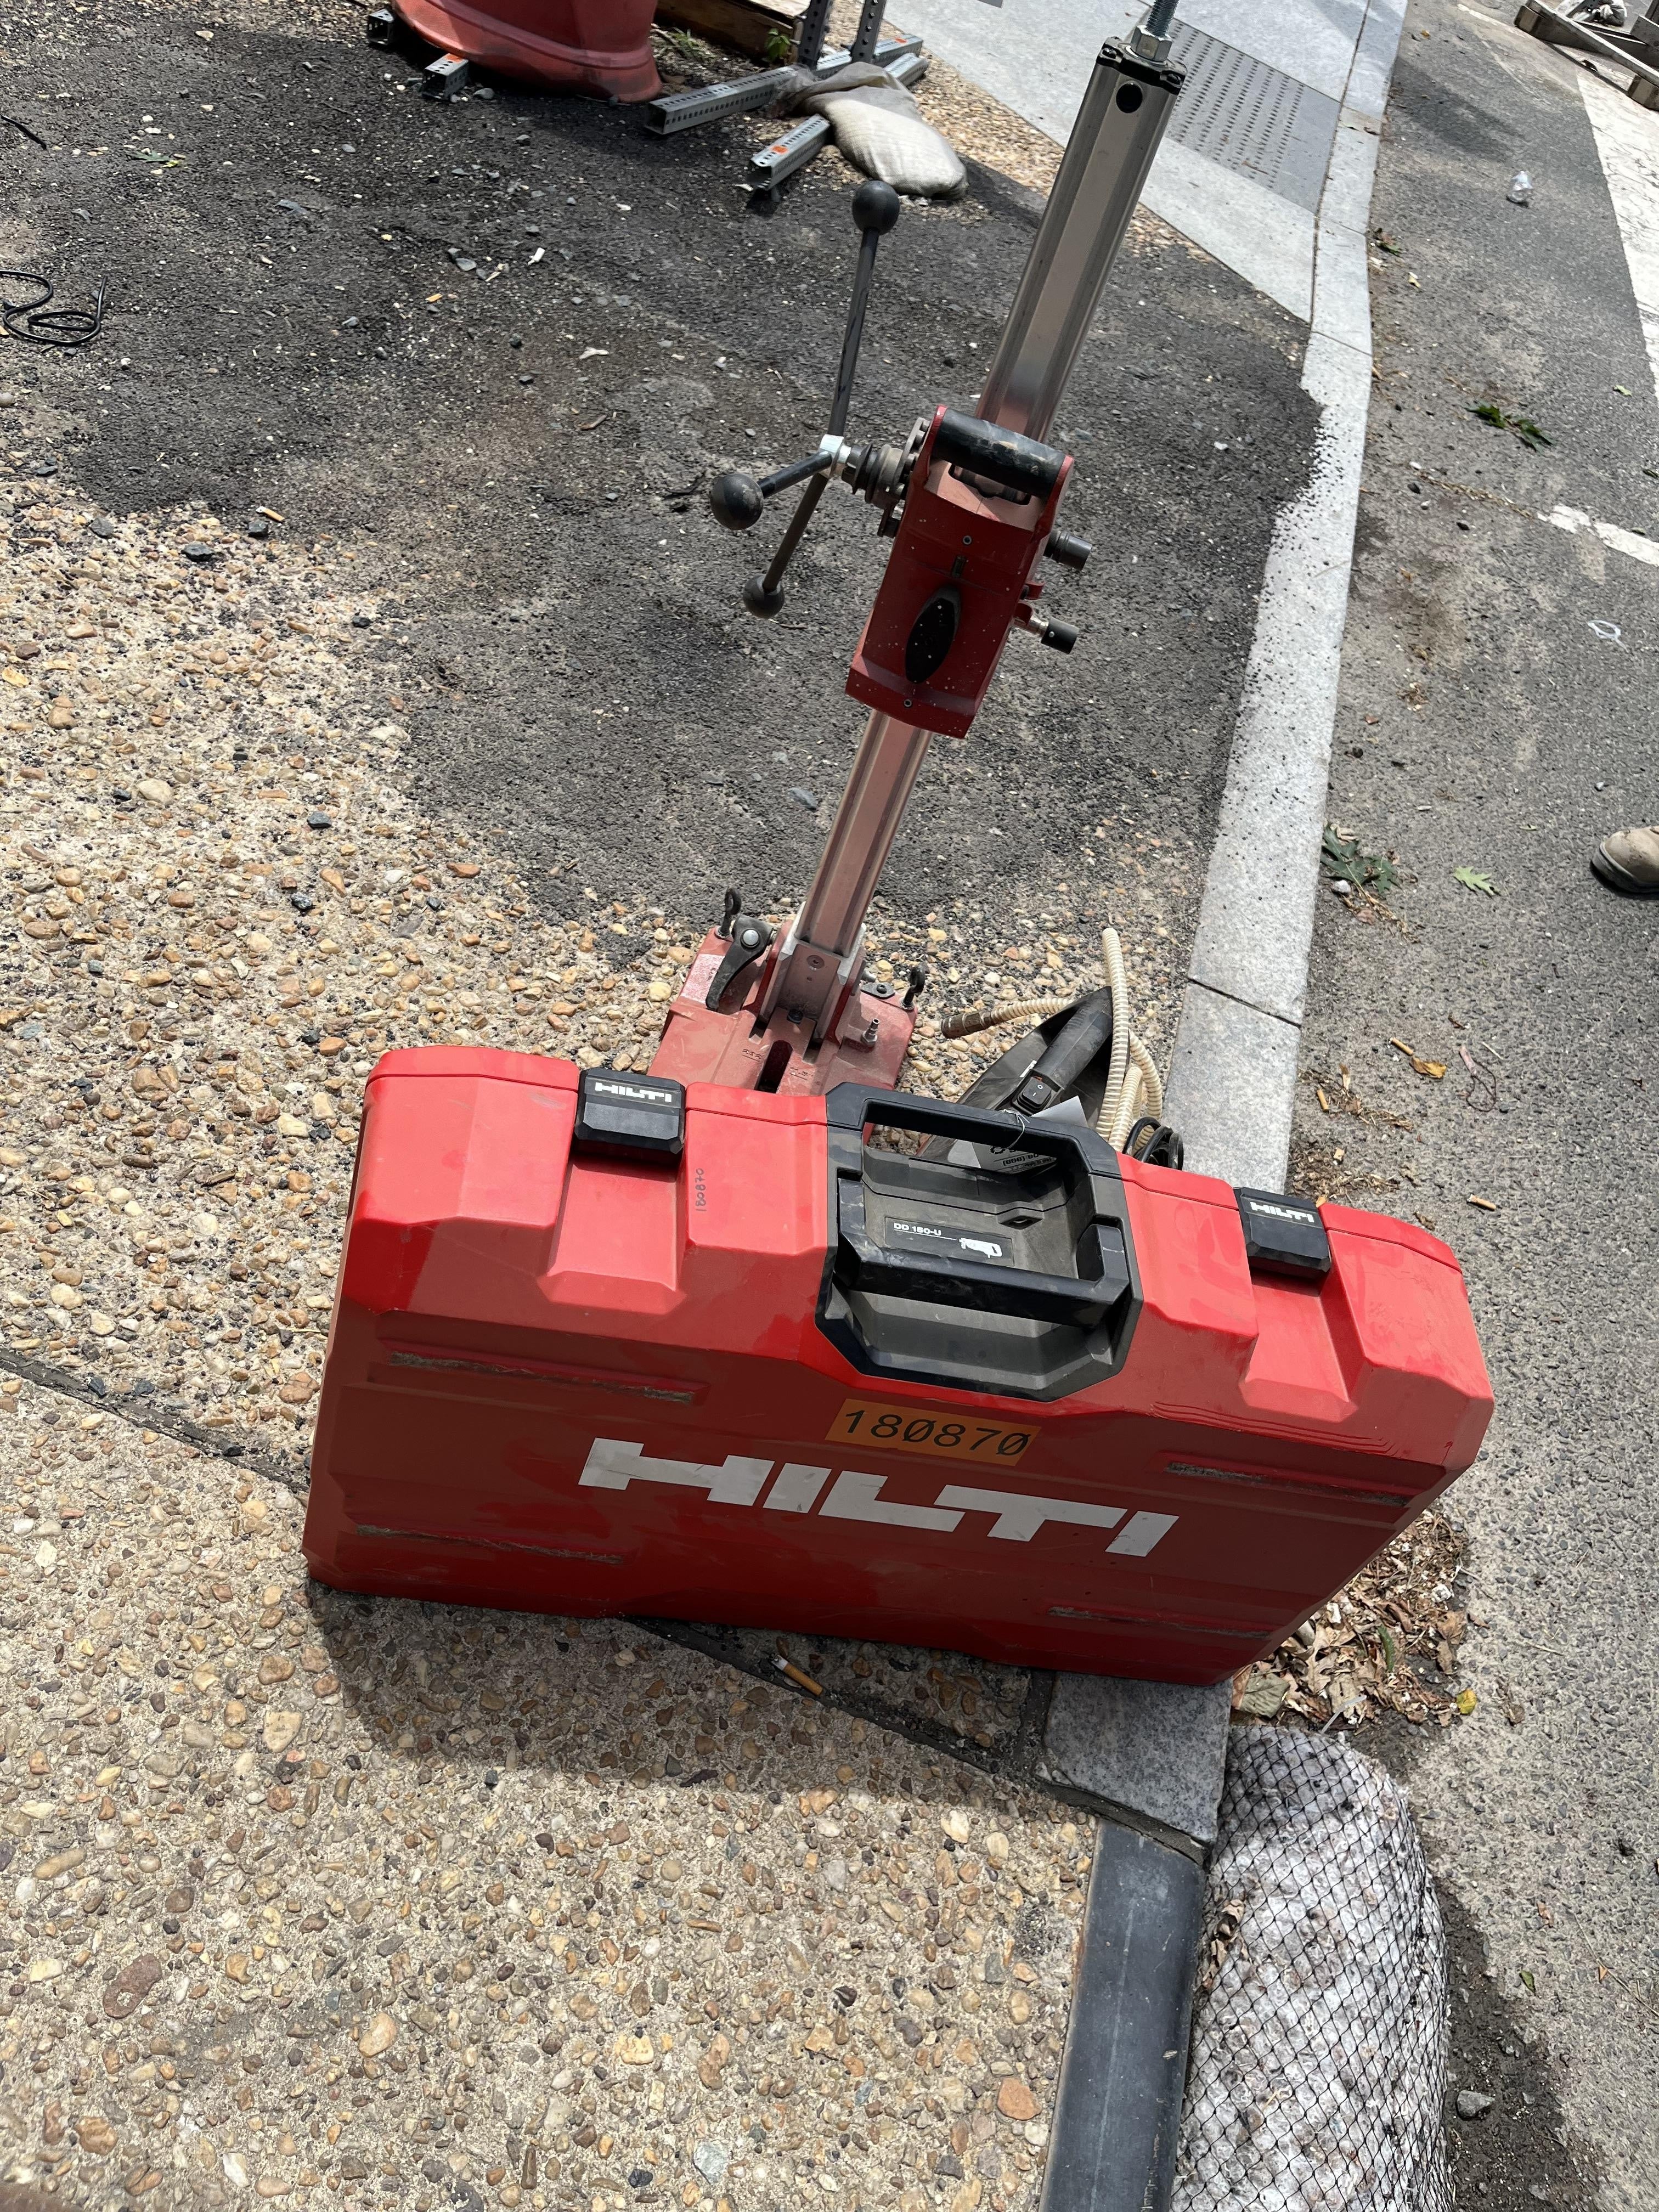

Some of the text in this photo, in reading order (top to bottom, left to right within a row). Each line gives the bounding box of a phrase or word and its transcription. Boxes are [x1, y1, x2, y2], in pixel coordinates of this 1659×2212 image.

[595, 1082, 672, 1103] HILTI
[695, 1168, 707, 1211] 180870
[1250, 1201, 1314, 1223] HILTI
[894, 1222, 942, 1237] DD 150-U
[845, 1409, 1032, 1456] 180870
[578, 1437, 1180, 1558] HILTI
